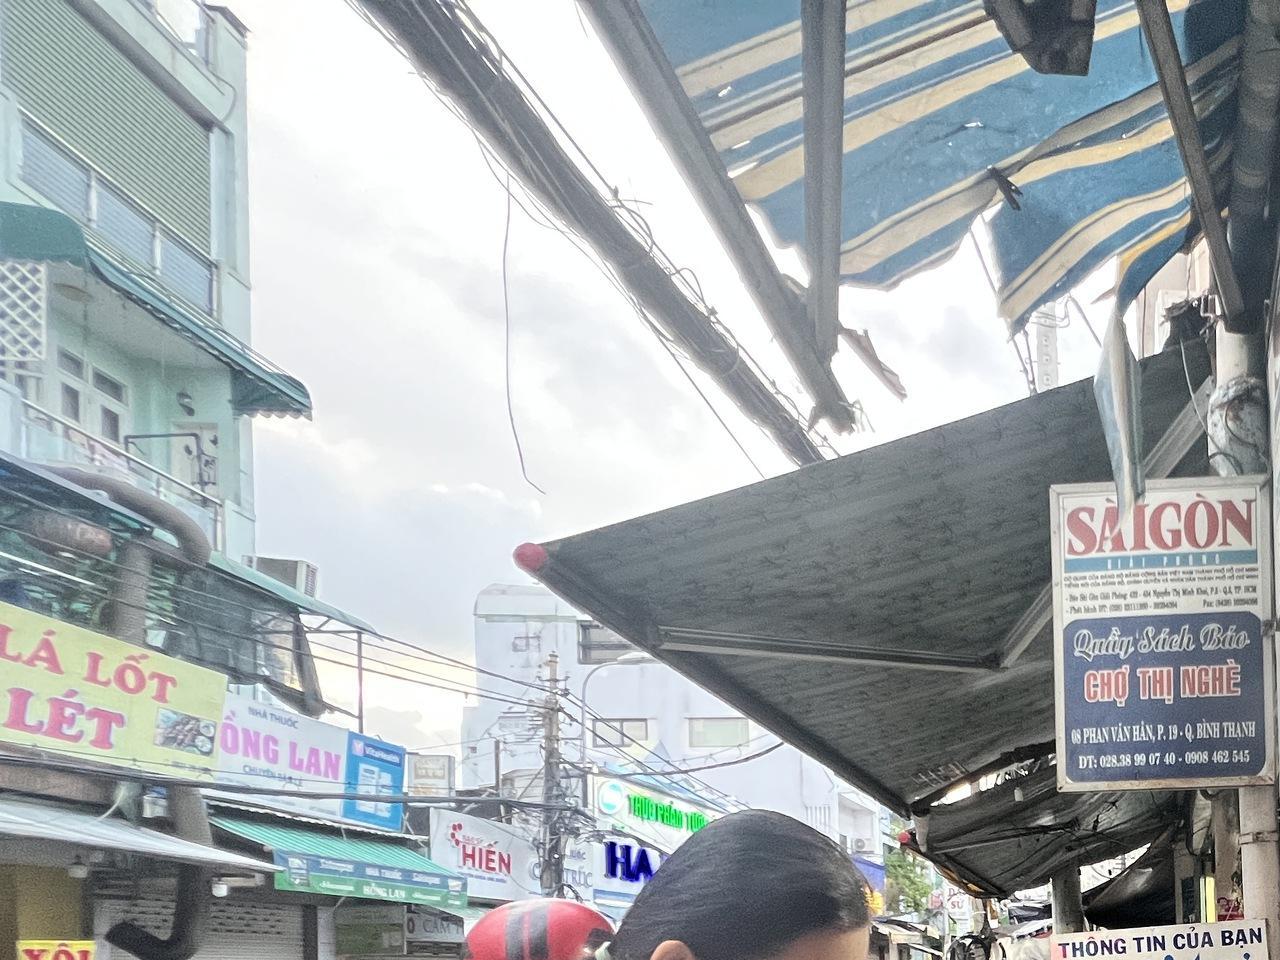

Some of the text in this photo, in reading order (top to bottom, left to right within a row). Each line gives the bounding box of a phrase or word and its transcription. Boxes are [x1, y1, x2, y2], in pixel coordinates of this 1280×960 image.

[1138, 625, 1195, 653] Sách
[1200, 624, 1250, 650] Báo
[83, 651, 178, 704] LỐT
[1084, 659, 1241, 706] CHỢ THỊ NGHÈ
[2, 687, 126, 750] LÉT
[1083, 726, 1109, 744] PHAN
[1169, 724, 1178, 740] 19
[1196, 719, 1220, 740] BÌNH
[220, 710, 342, 781] ỒNG LAN
[1134, 753, 1147, 766] 99
[1149, 752, 1160, 766] 07
[1164, 752, 1175, 765] 40
[1185, 750, 1208, 764] 0908
[1211, 750, 1229, 763] 462
[1058, 926, 1262, 959] THÔNG TIN CỦA BẠN
